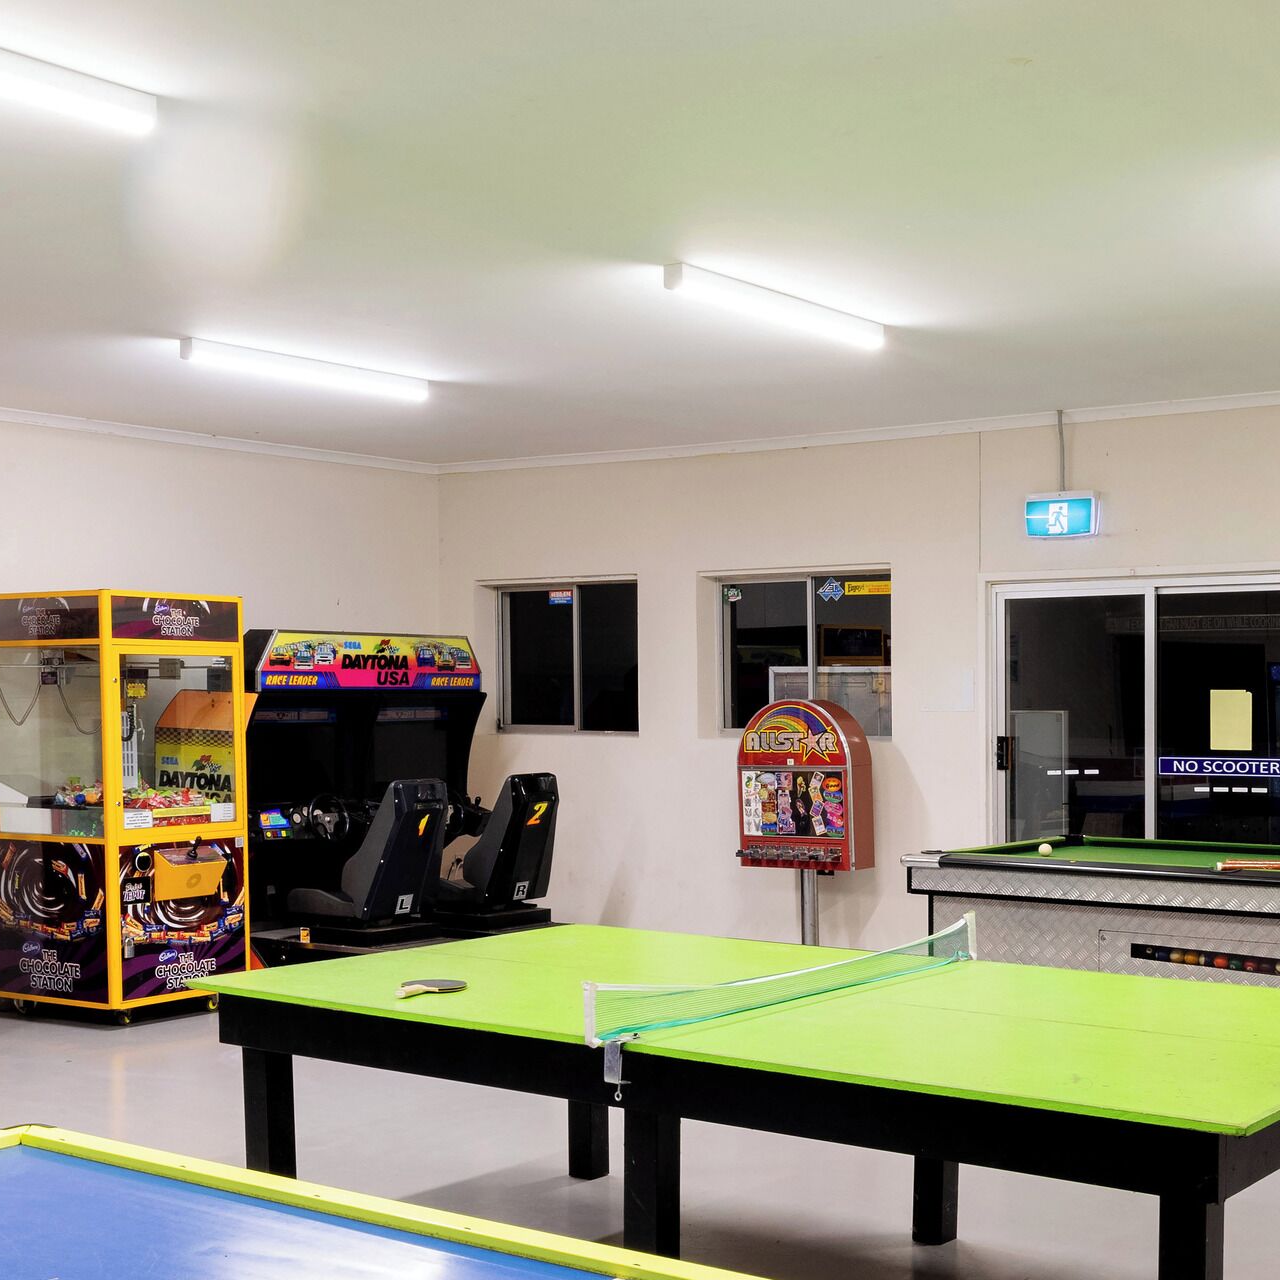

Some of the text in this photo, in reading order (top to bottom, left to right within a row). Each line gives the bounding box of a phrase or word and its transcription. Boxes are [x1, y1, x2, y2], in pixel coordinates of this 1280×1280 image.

[170, 608, 182, 617] THE
[21, 614, 61, 626] CHOCOLATE
[152, 615, 200, 627] CHOCOLATE
[28, 625, 56, 635] STATION
[161, 625, 194, 636] STATION
[343, 641, 362, 650] SEGA
[341, 654, 410, 671] DAYTONA
[266, 675, 318, 686] RACE LEADER
[376, 671, 410, 686] USA
[431, 676, 474, 687] RACE LEADER
[1173, 760, 1199, 772] NO
[159, 770, 232, 792] DAYTONA
[527, 802, 548, 826] 2
[418, 814, 430, 837] 1
[516, 885, 526, 897] R
[398, 898, 409, 911] L
[42, 949, 57, 961] THE
[178, 952, 194, 963] THE
[19, 957, 81, 978] CHOCOLATE
[155, 958, 216, 979] CHOCOLATE
[30, 974, 73, 992] STATION
